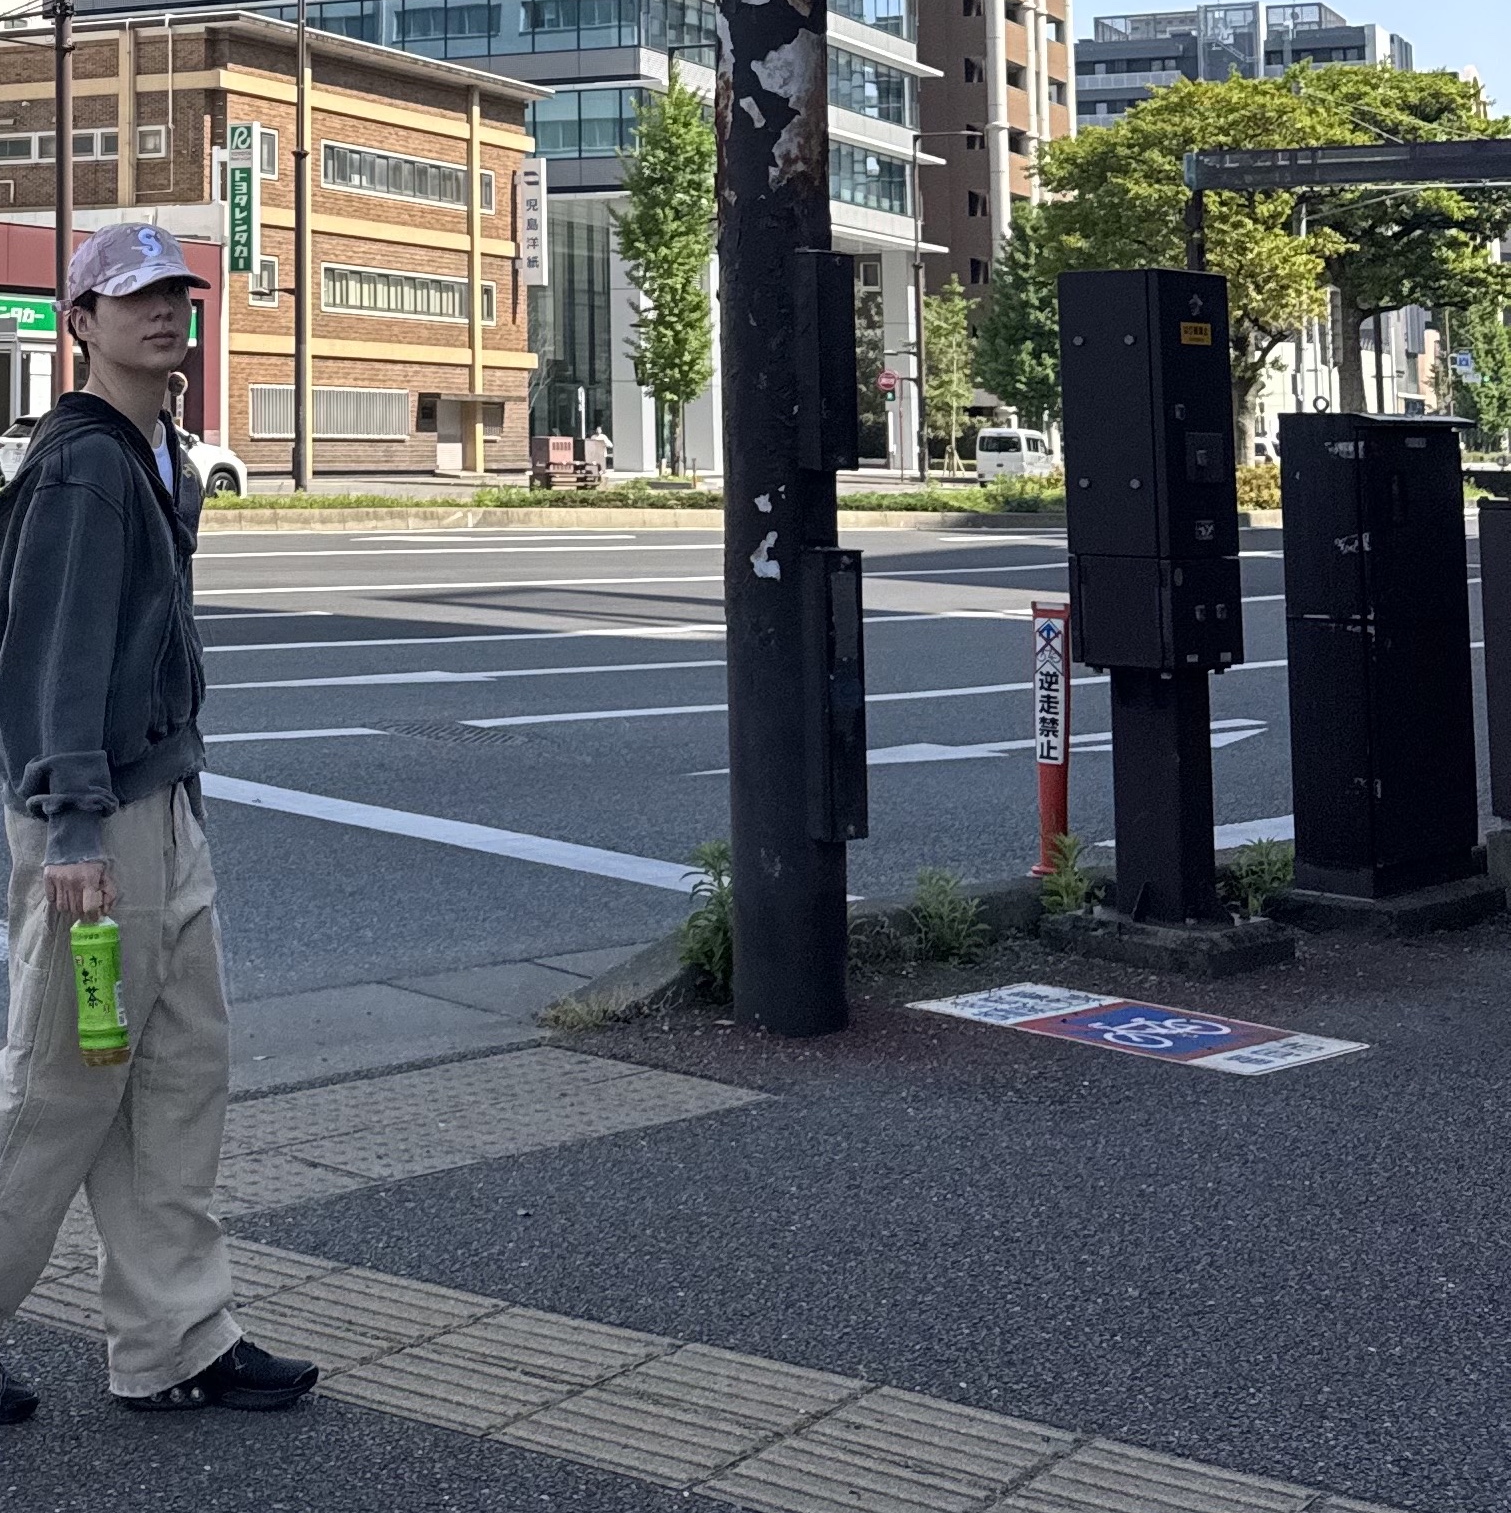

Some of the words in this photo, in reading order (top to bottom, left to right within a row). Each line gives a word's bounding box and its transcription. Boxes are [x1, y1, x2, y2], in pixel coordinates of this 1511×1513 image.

[137, 227, 163, 258] S
[234, 169, 248, 269] トヨタレンタカー
[526, 198, 540, 269] 児島洋紙
[1038, 670, 1060, 761] 逆走禁止
